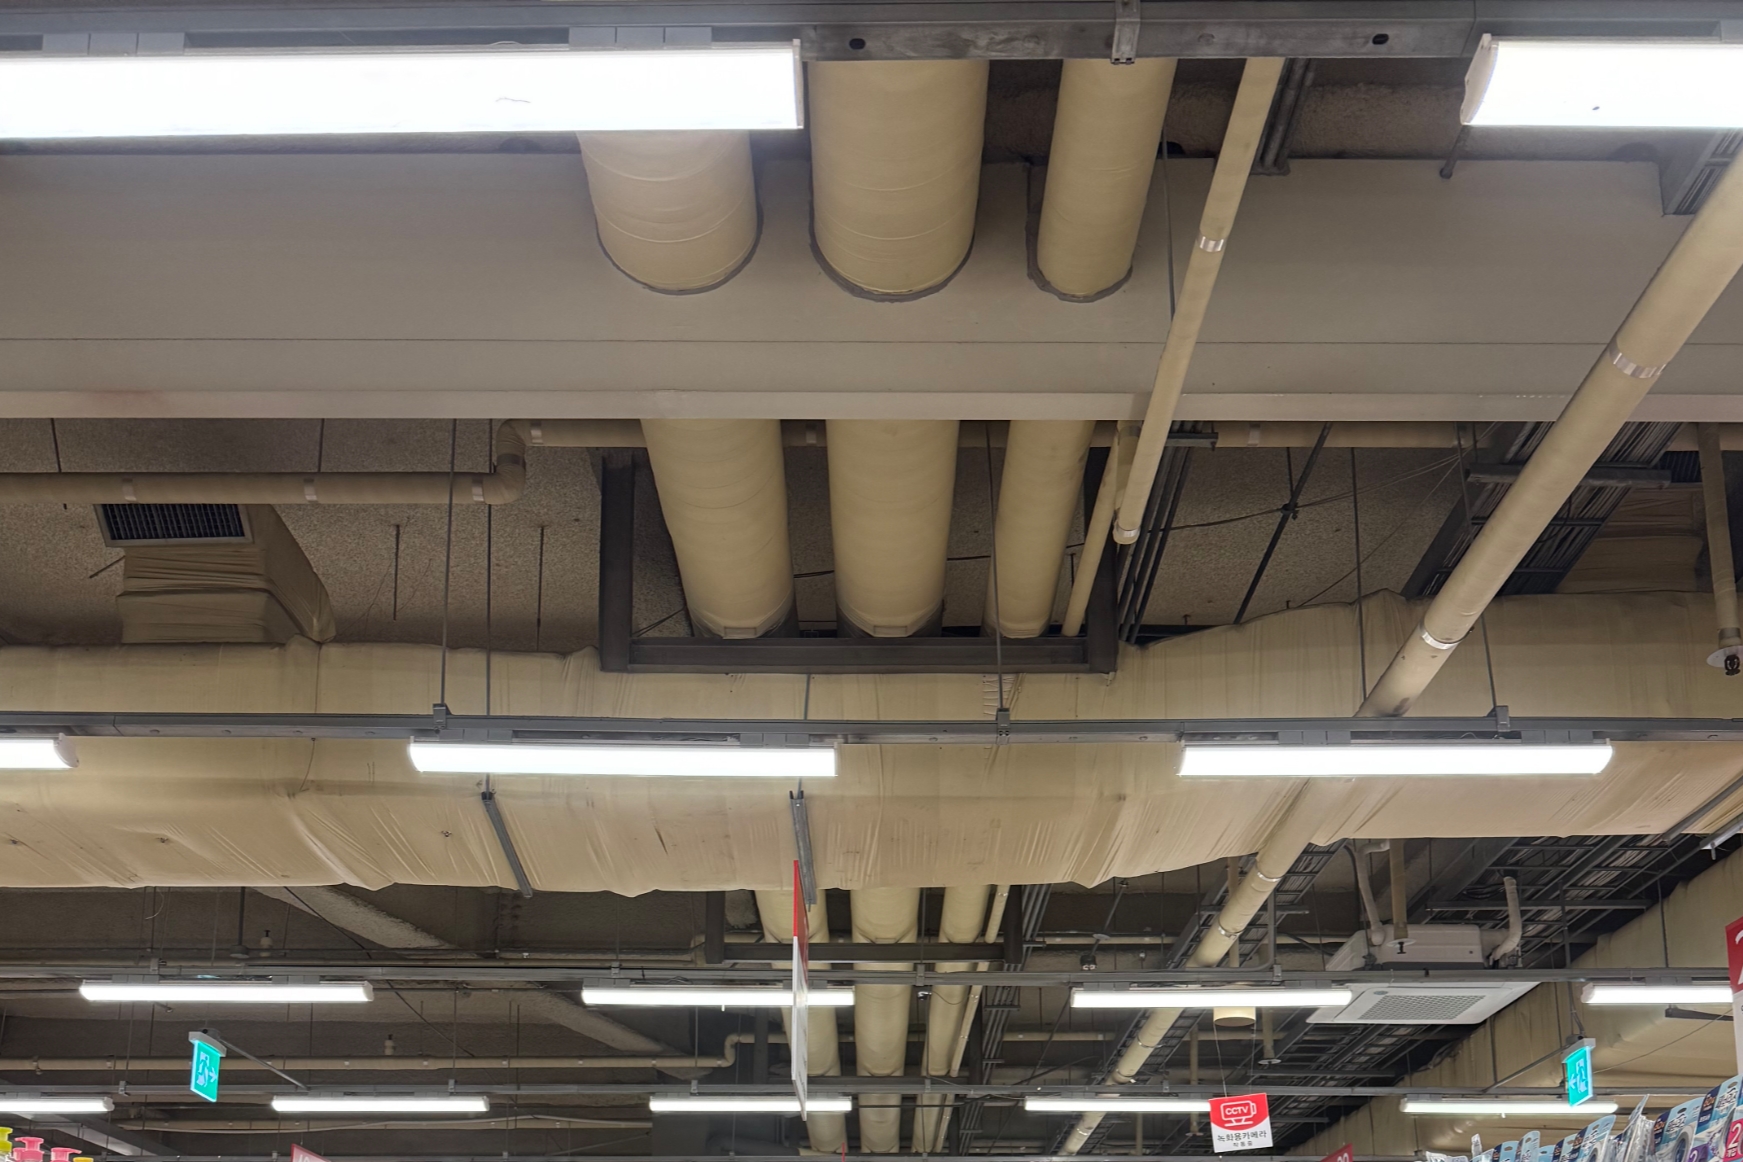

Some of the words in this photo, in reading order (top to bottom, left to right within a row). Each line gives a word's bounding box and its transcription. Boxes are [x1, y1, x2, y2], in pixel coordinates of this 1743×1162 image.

[1225, 1106, 1249, 1115] CCTV
[1217, 1130, 1267, 1142] 녹화용카메라
[1728, 1123, 1741, 1148] 2
